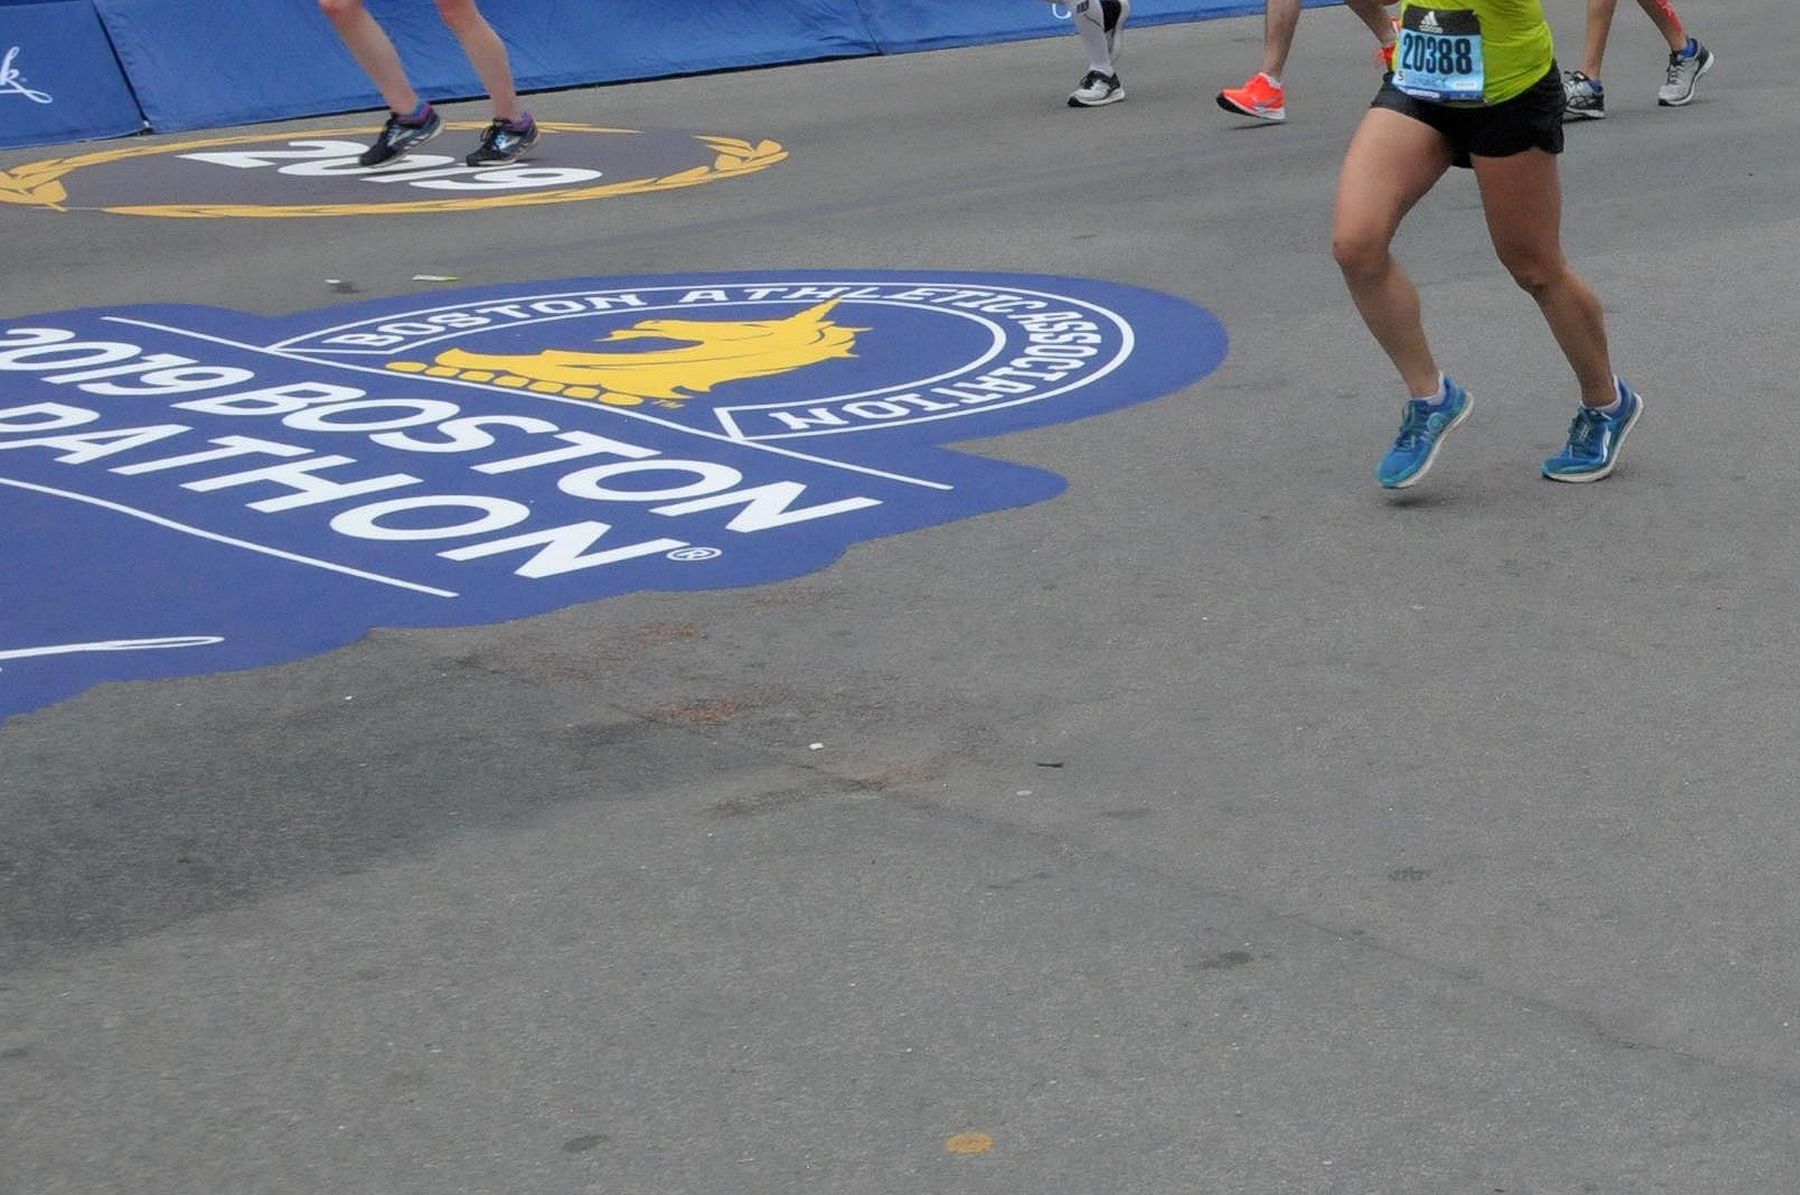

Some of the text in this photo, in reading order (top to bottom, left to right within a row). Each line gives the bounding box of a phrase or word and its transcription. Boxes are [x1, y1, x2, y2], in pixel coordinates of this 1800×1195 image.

[1402, 32, 1473, 75] 20388
[0, 327, 884, 534] 2019 BOSTON
[322, 287, 1102, 431] BOSTON ATHLETIC ASSOCIATION
